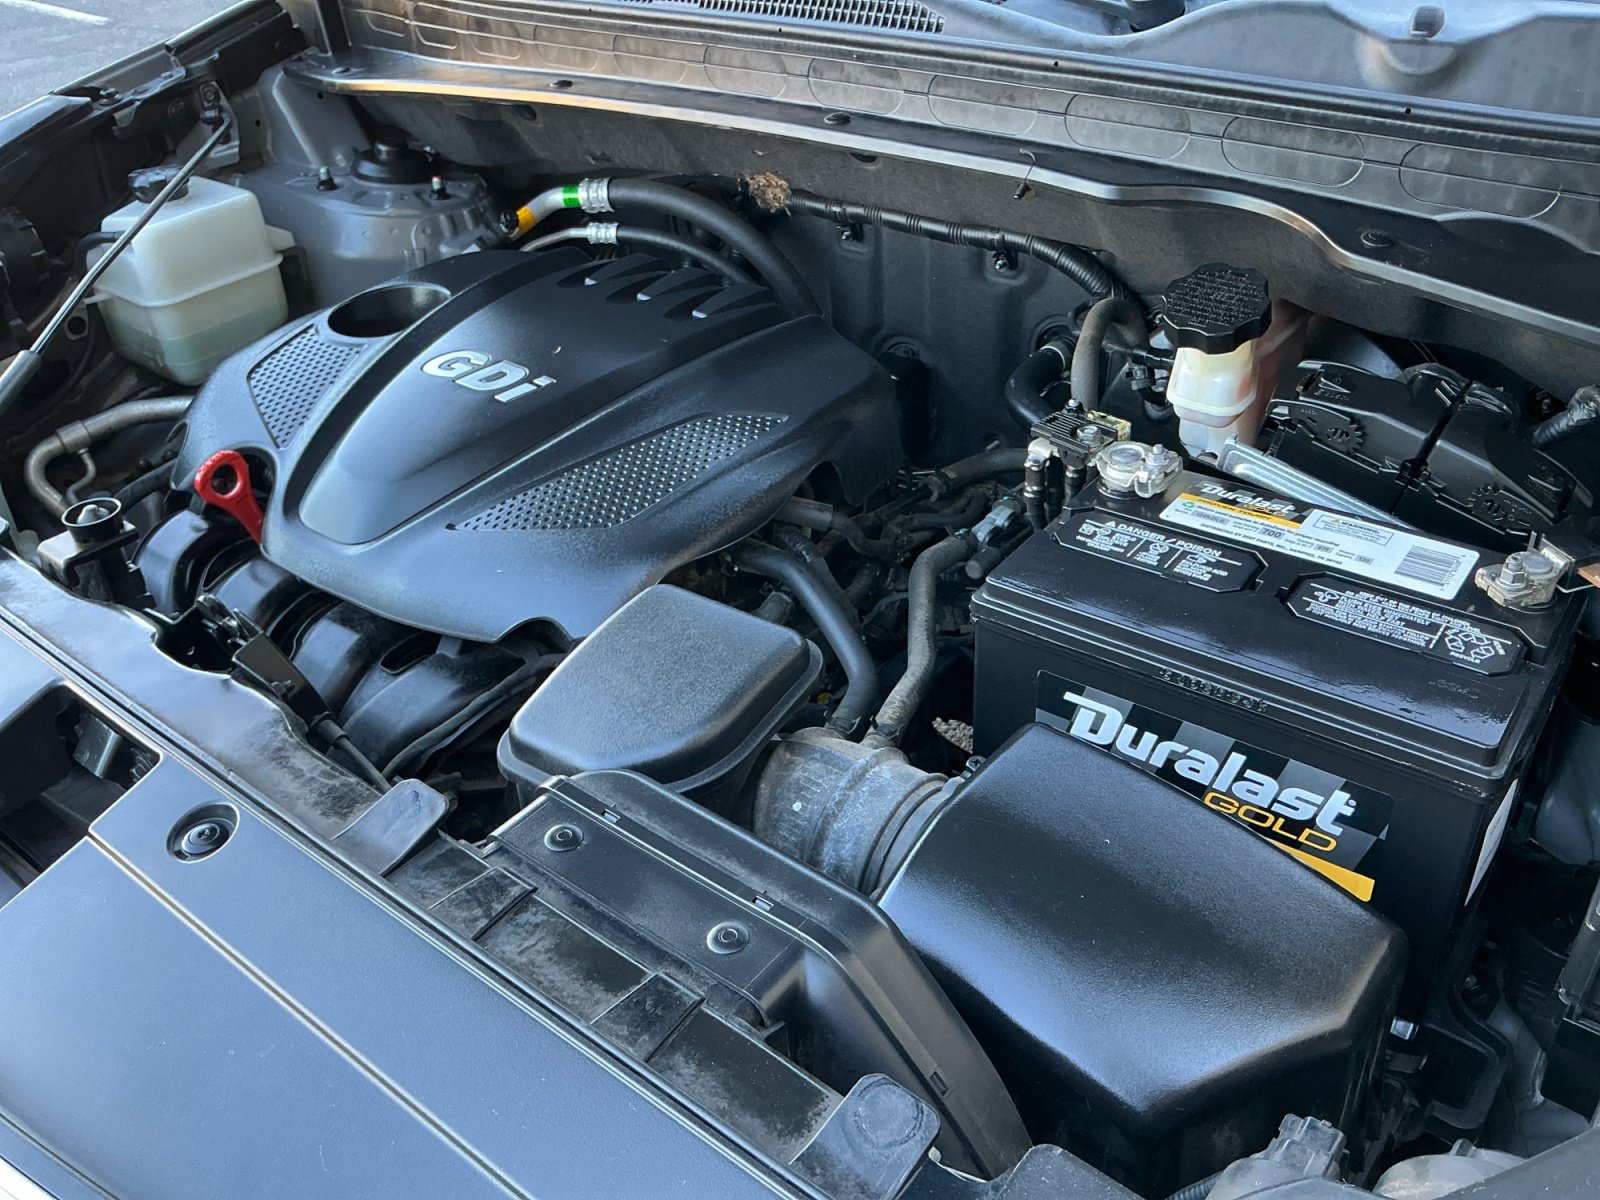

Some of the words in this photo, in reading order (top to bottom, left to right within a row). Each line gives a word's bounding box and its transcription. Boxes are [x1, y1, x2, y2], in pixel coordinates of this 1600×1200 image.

[421, 350, 557, 403] GDi
[1201, 483, 1295, 513] Duralast
[1117, 524, 1165, 541] DANGER
[1175, 540, 1221, 556] POISON
[1262, 529, 1281, 538] 700
[1063, 691, 1355, 836] Duralast
[1204, 791, 1338, 851] GOLD
